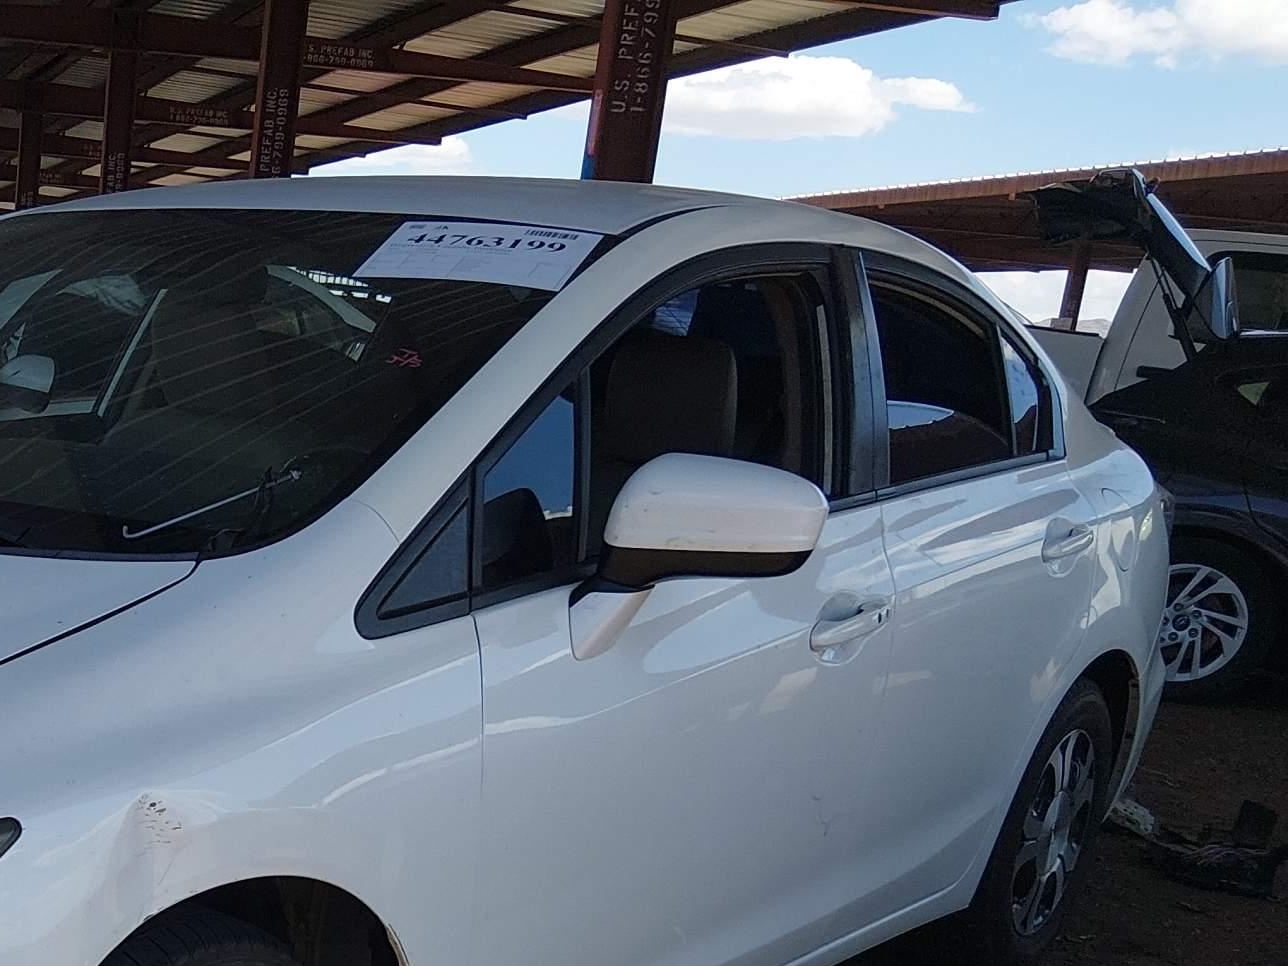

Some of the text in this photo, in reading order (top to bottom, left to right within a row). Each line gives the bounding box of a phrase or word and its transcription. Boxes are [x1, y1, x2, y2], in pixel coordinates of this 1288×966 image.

[610, 0, 642, 113] U.S. PREF
[259, 119, 274, 172] PREFAB
[272, 88, 289, 178] 6-799-0969
[407, 233, 567, 253] 44763199
